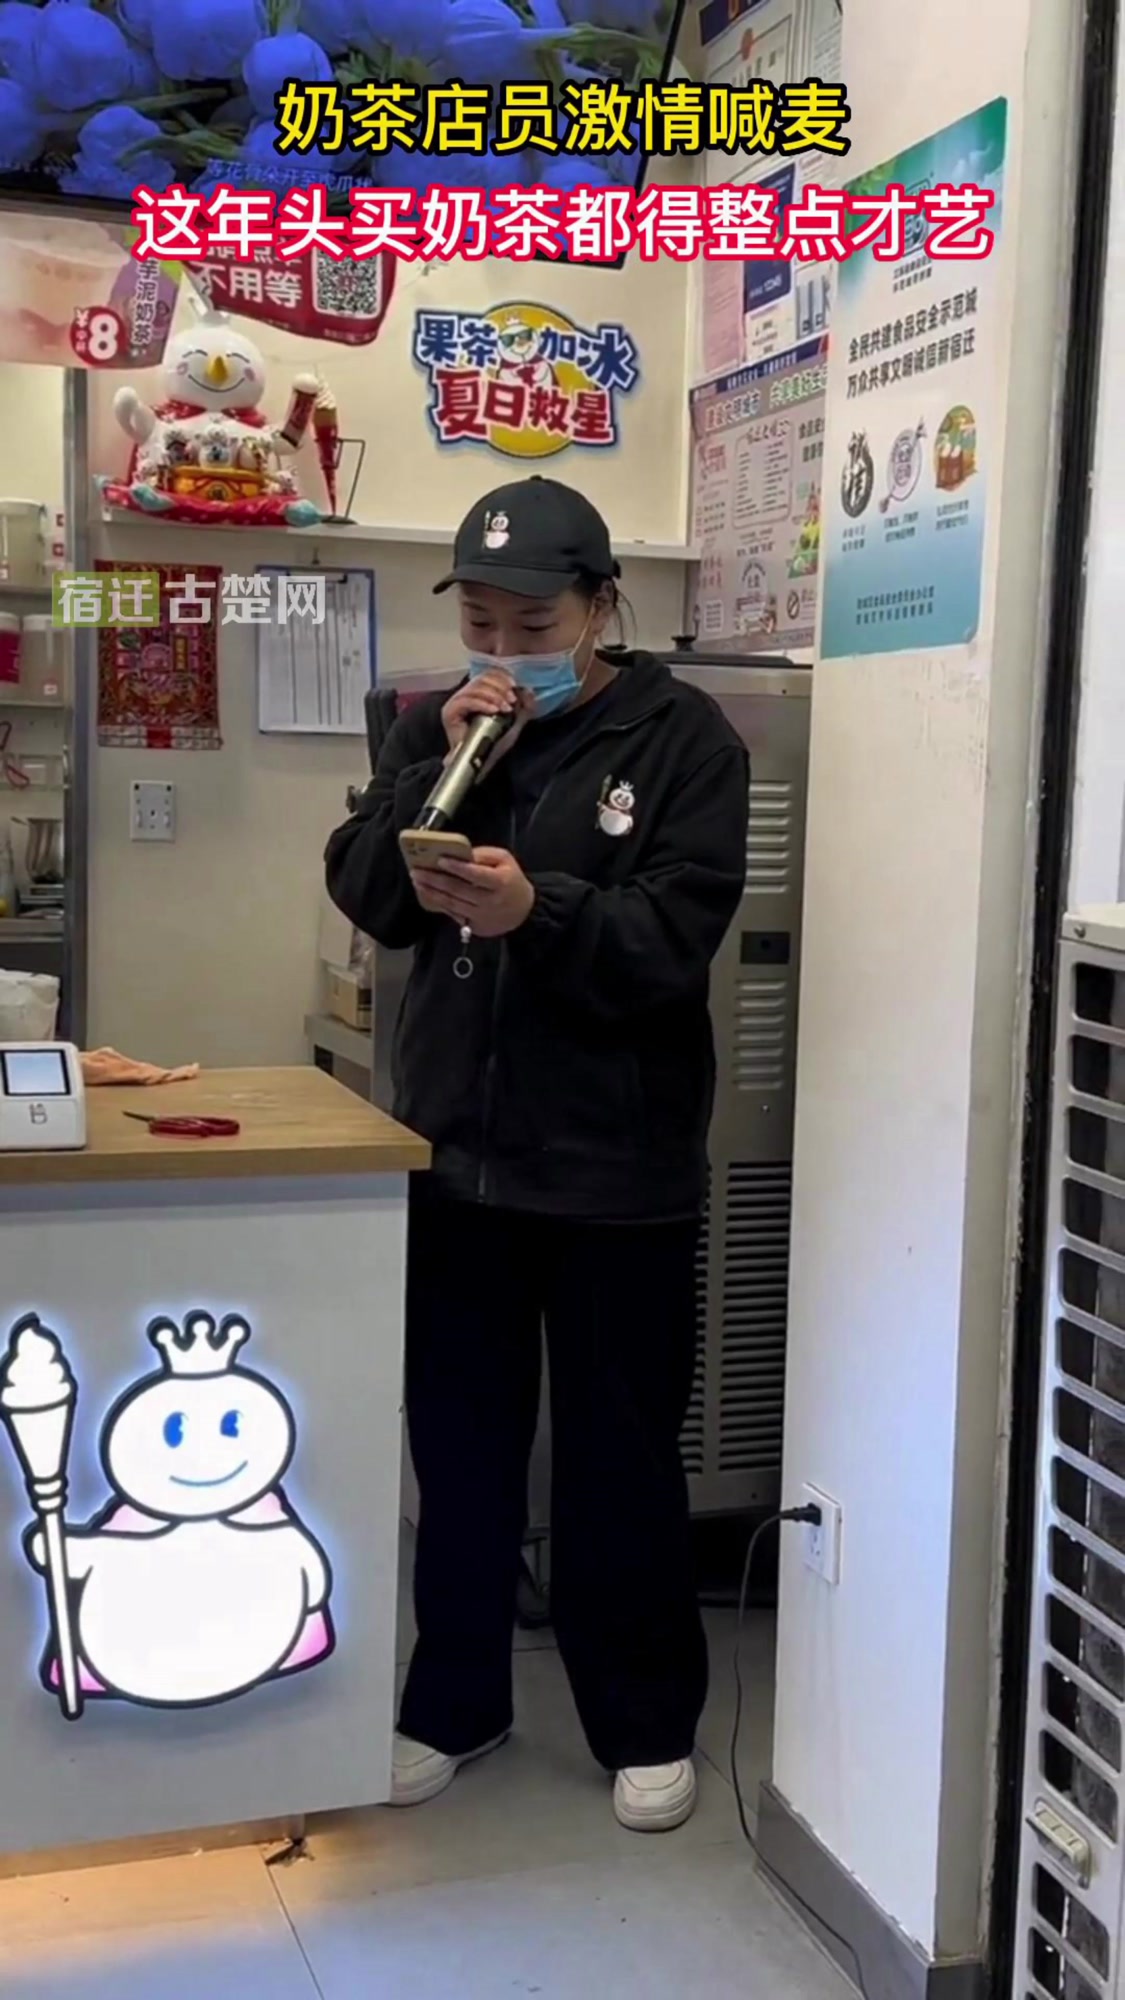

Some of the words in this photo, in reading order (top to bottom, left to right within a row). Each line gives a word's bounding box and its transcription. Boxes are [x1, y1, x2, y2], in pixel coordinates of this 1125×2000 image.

[188, 261, 303, 308] 不用等
[418, 315, 633, 388] 果茶加冰
[848, 286, 978, 364] 全民共建食品安全示范城
[434, 368, 613, 441] 夏日救星
